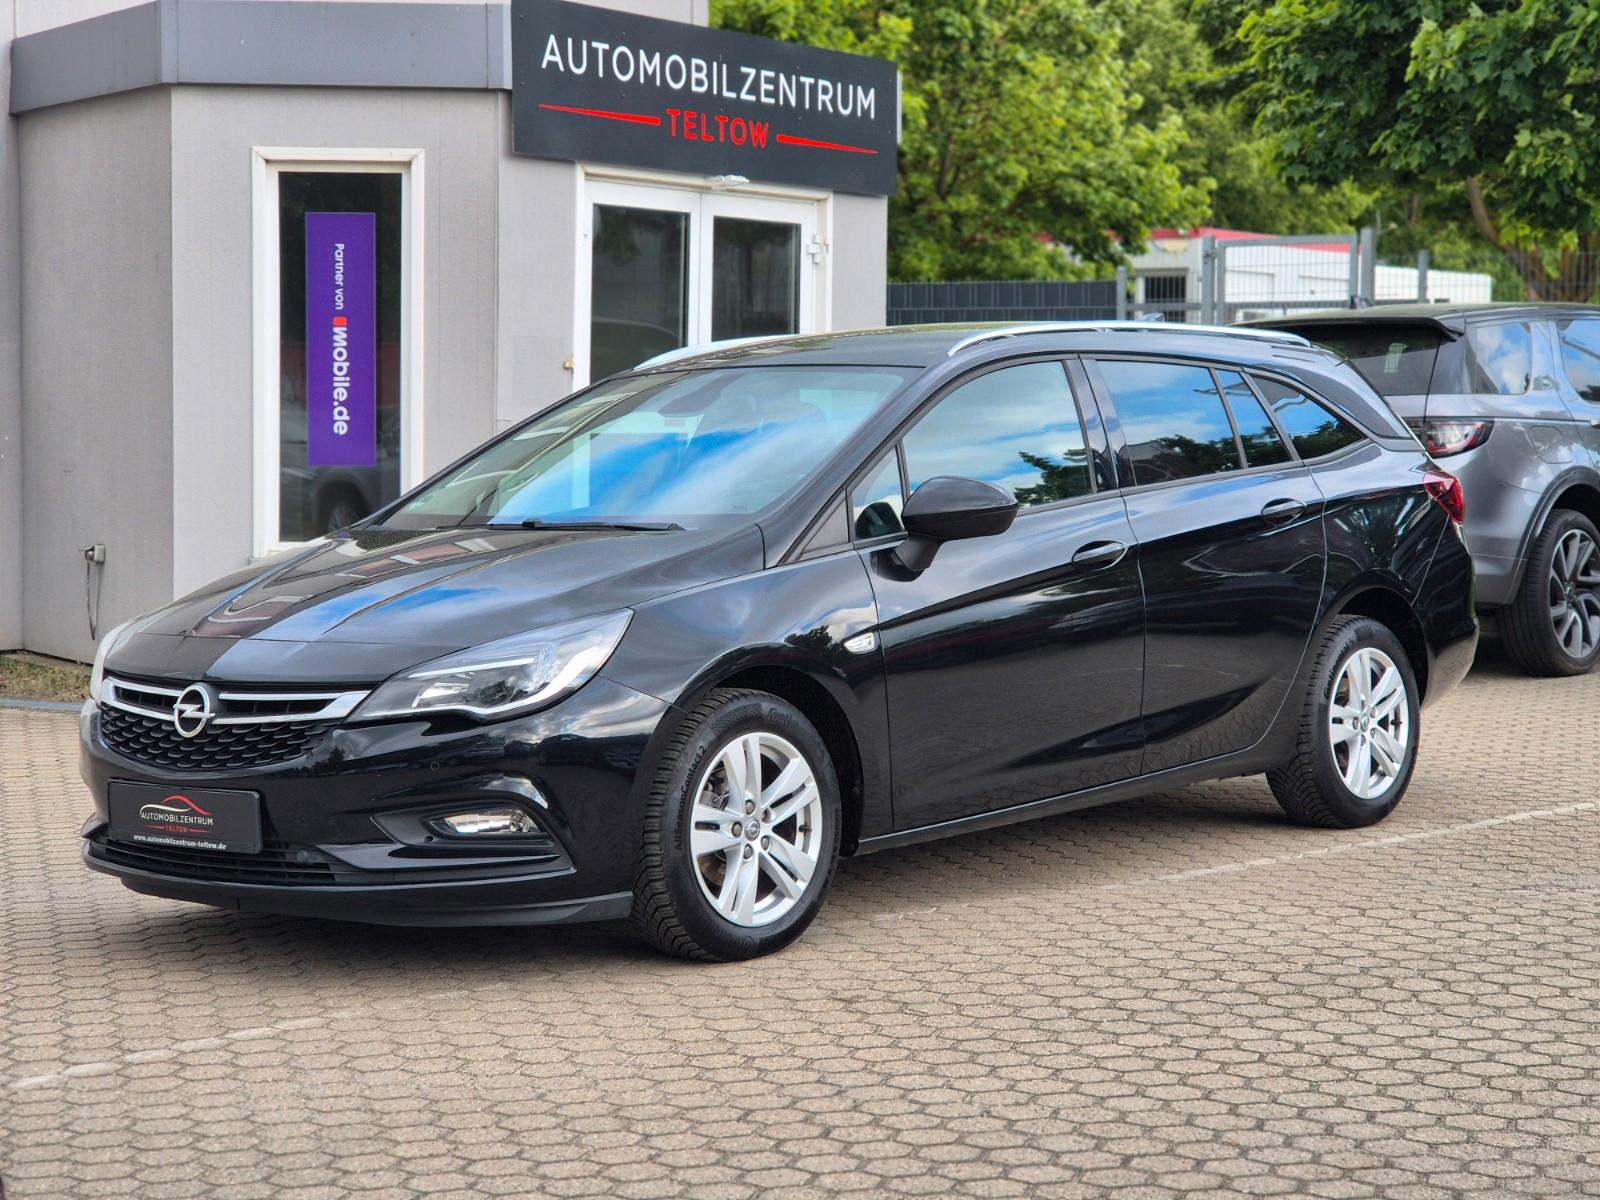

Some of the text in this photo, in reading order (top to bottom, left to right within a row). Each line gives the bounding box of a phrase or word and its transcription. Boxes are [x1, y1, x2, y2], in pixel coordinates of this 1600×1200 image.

[541, 33, 876, 120] AUTOMOBILZENTRUM
[666, 108, 769, 149] TELTOW
[334, 243, 345, 310] Partner von
[332, 326, 350, 436] mobile.de
[141, 813, 213, 825] AUTOMOBILZENTRUM
[165, 824, 188, 833] TELTOW
[133, 834, 227, 850] www.automobilzentrum-teltow.de
